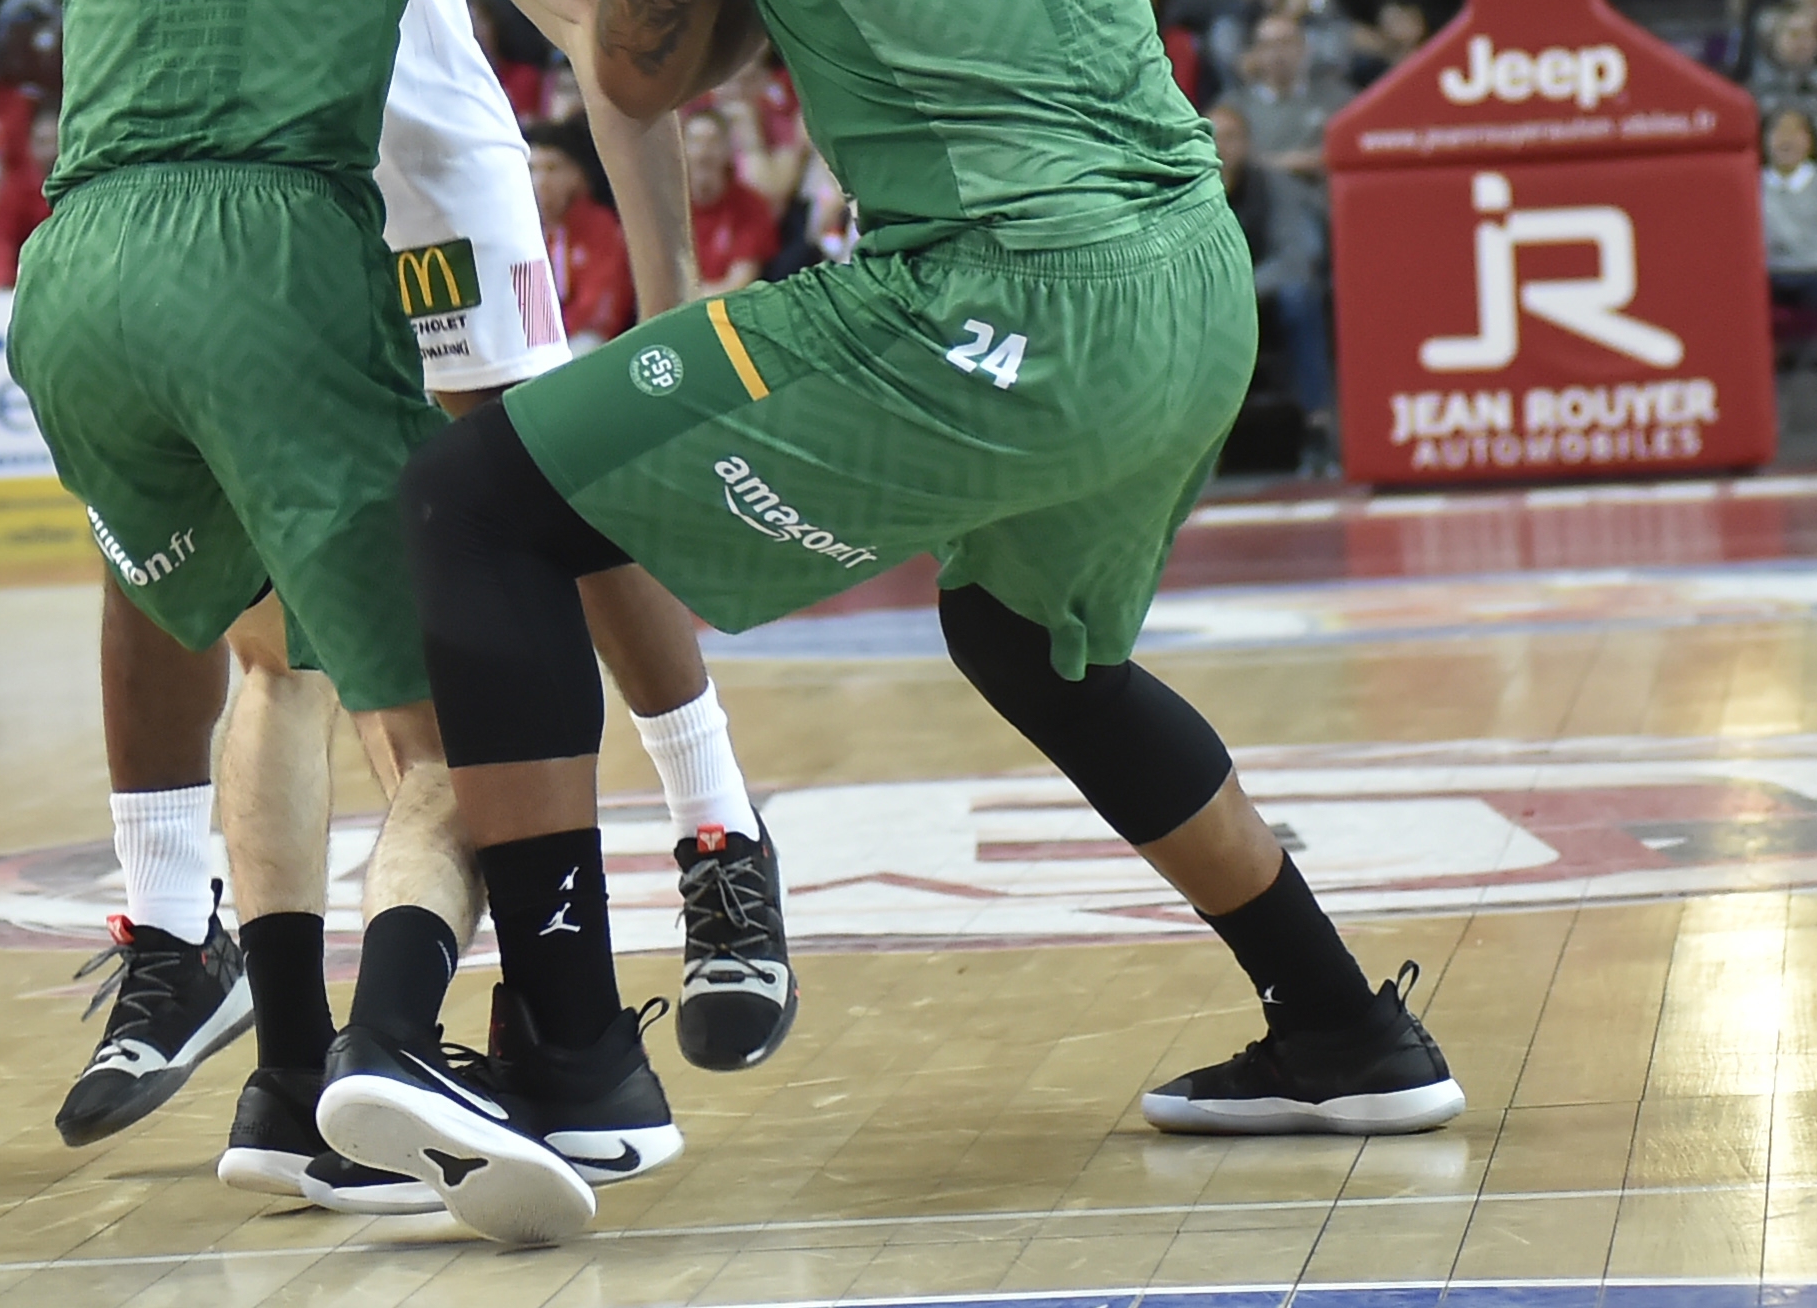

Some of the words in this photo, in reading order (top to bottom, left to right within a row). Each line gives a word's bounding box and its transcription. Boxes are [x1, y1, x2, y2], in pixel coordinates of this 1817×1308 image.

[1439, 34, 1627, 108] Jeep
[412, 315, 468, 336] HOLET
[640, 350, 674, 387] CSP
[946, 319, 1027, 390] 24
[1389, 389, 1514, 445] JEAN
[1523, 379, 1719, 432] ROUYER
[1411, 426, 1703, 470] AUTOMOBILES
